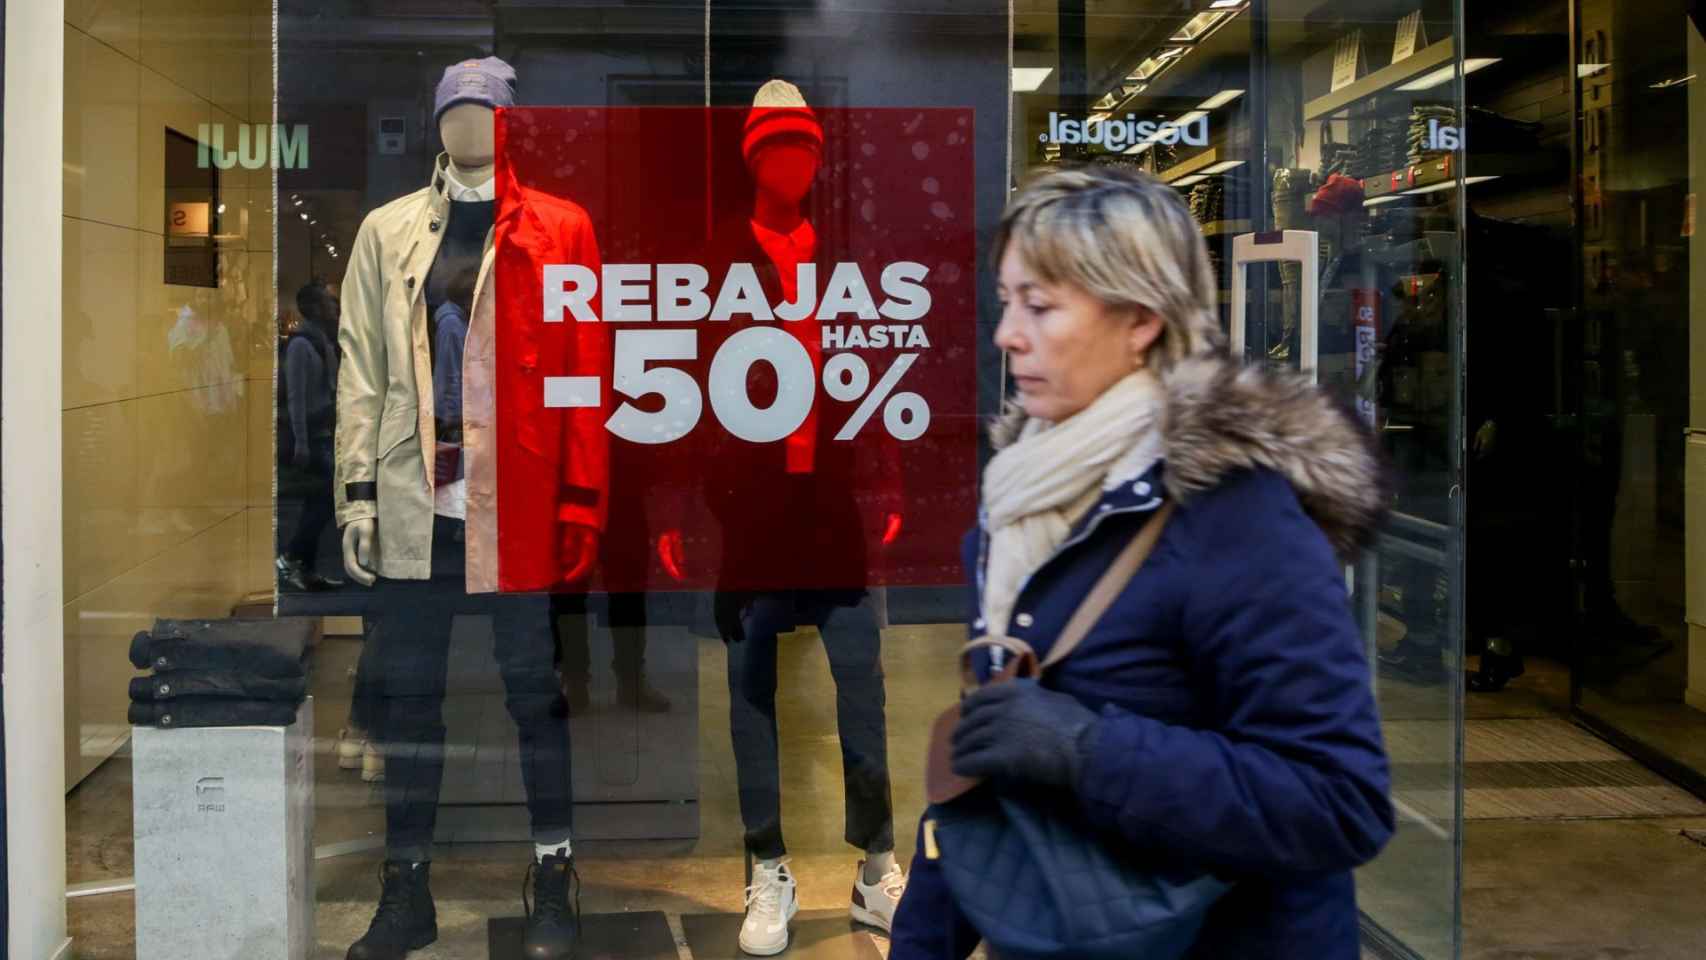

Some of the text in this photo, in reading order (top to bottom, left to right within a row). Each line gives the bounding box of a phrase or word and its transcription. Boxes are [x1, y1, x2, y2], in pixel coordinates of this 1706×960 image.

[542, 261, 932, 322] REBAJAS
[821, 325, 931, 349] HASTA
[543, 325, 931, 445] -50%
